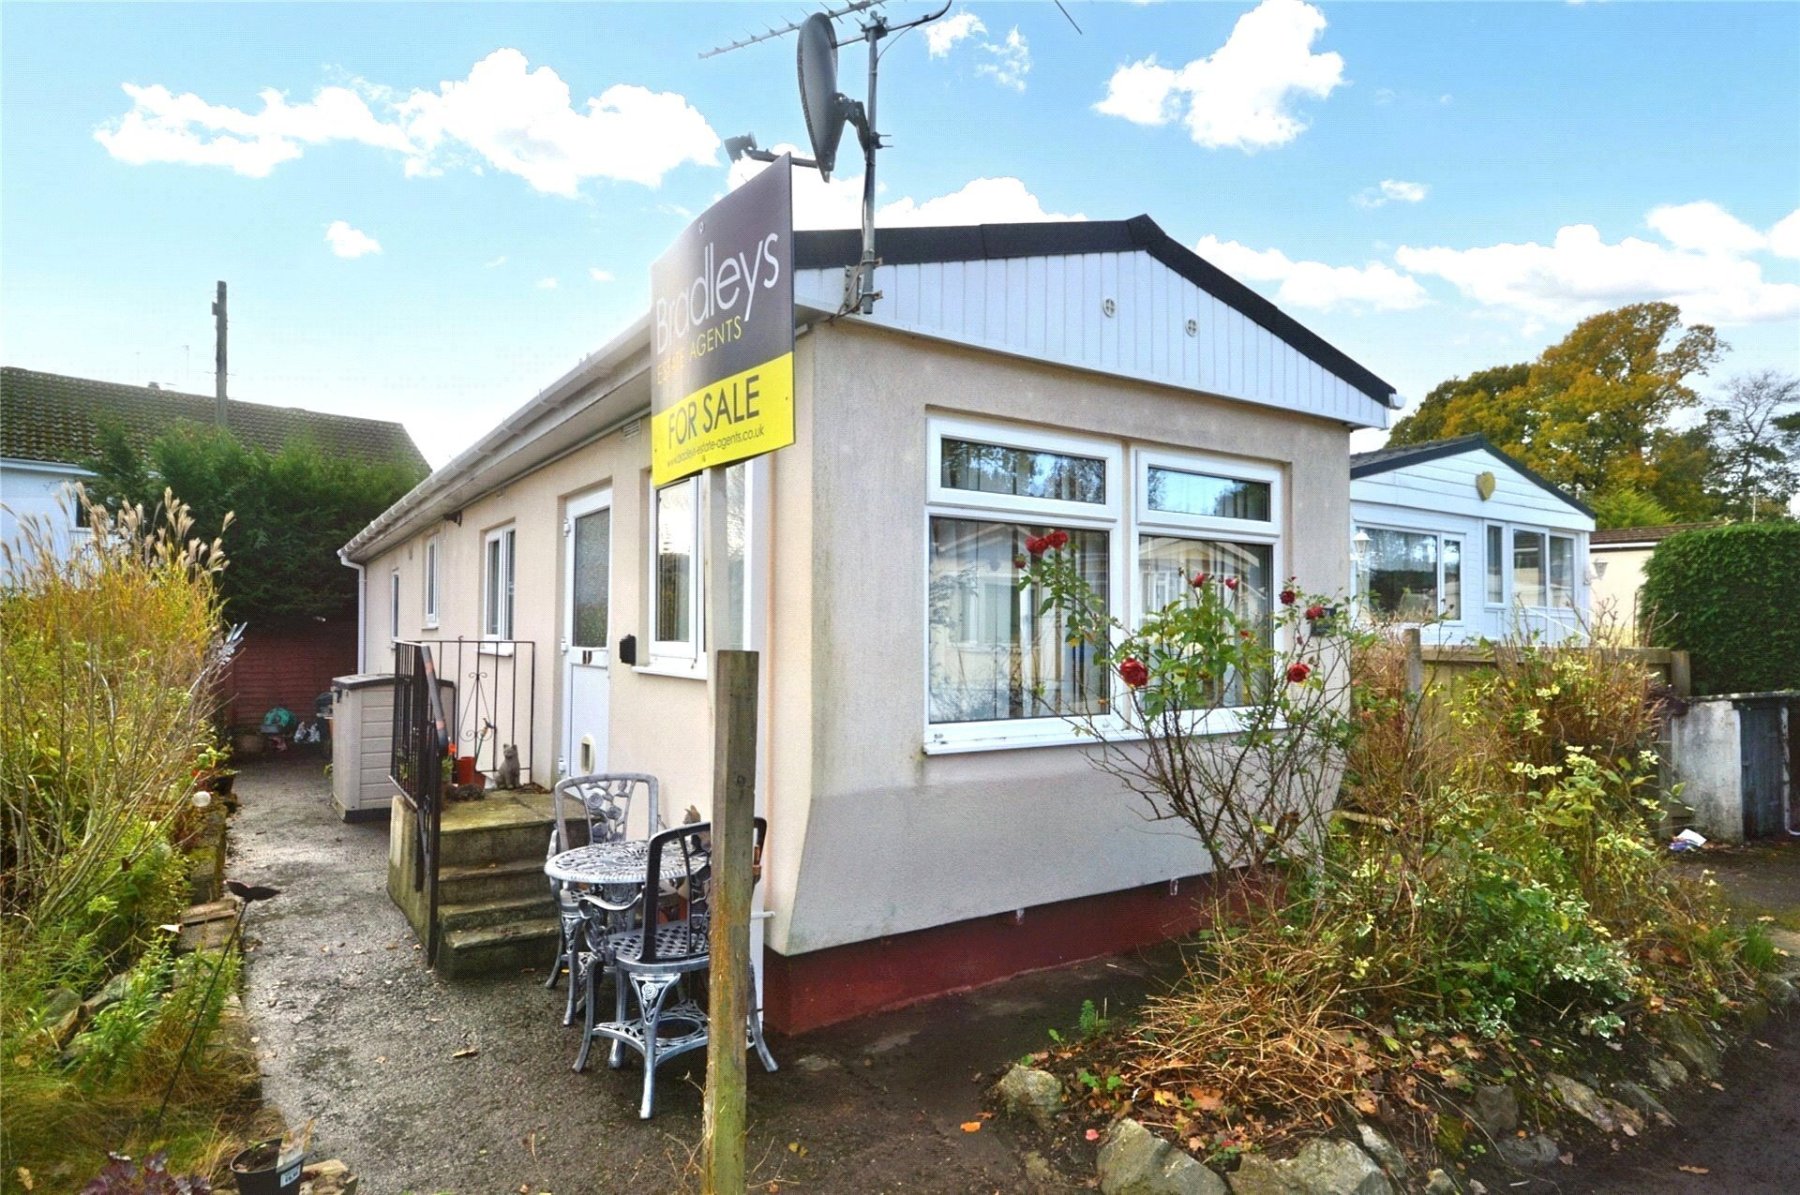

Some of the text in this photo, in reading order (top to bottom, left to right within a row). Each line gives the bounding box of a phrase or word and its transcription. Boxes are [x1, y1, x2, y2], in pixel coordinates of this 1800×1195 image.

[656, 232, 780, 356] Bradleys
[690, 315, 742, 359] AGENTS
[668, 374, 760, 450] FOR SALE
